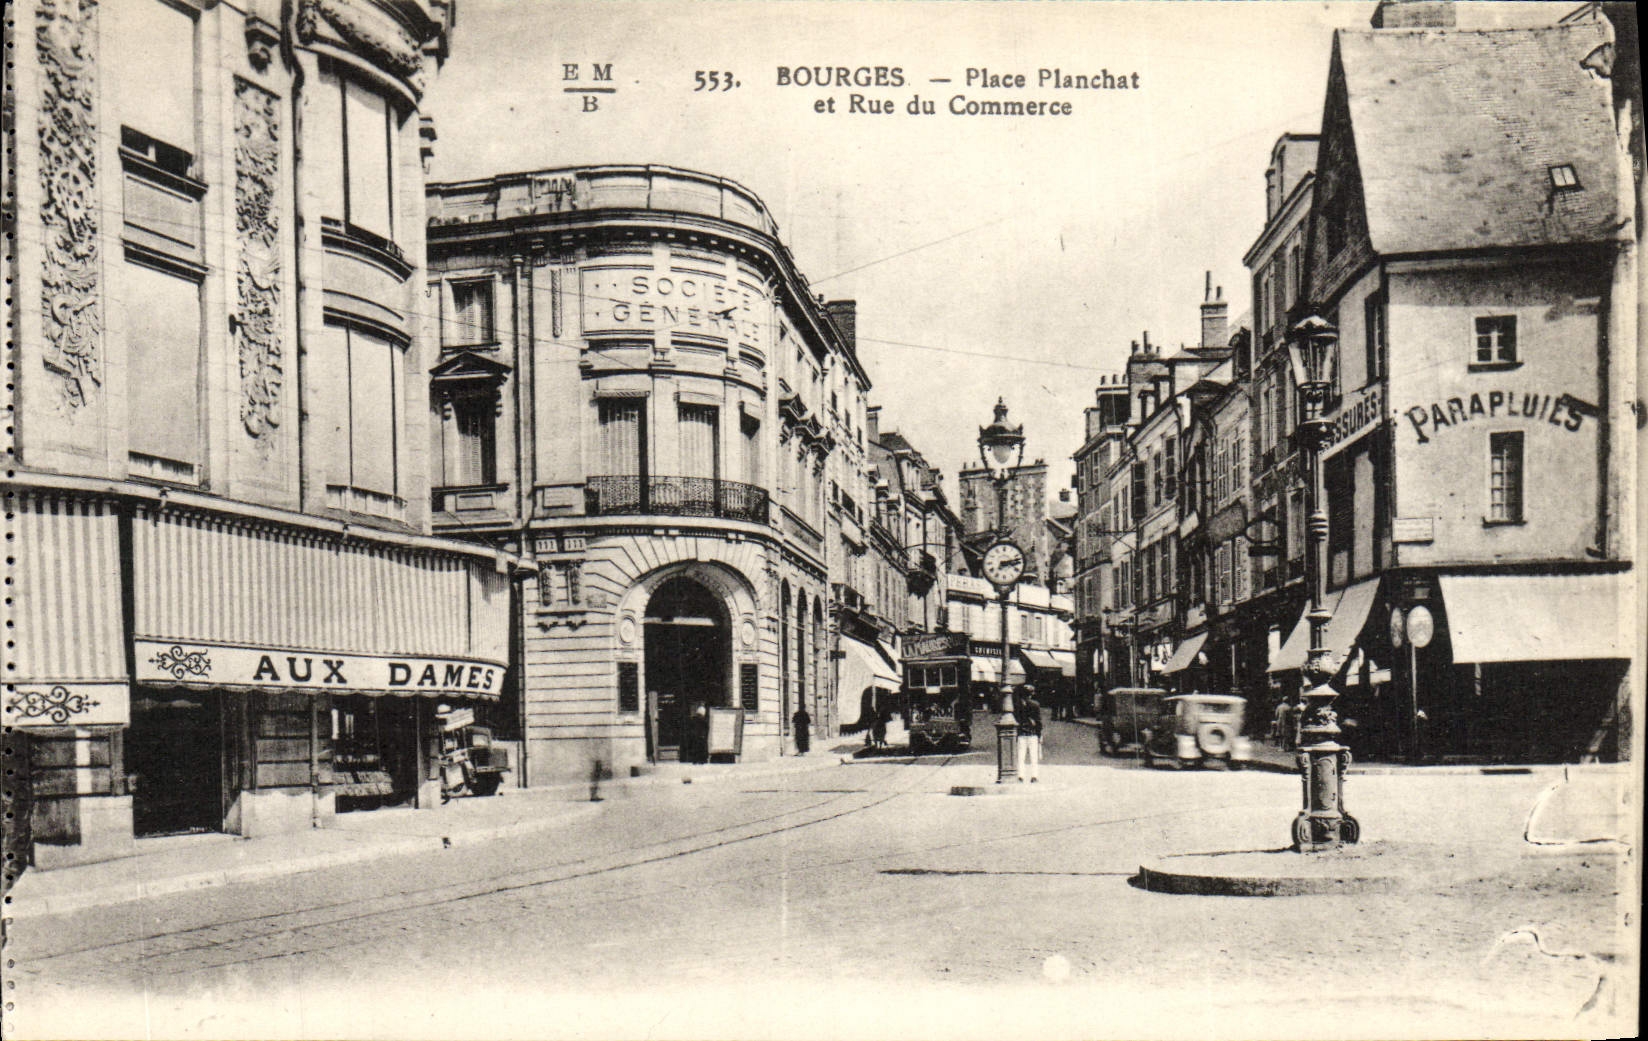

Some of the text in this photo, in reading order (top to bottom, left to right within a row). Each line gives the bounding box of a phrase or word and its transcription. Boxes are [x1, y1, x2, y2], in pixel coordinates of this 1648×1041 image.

[1404, 390, 1584, 444] PARAPLUIES
[253, 655, 495, 690] AUX DAMES
